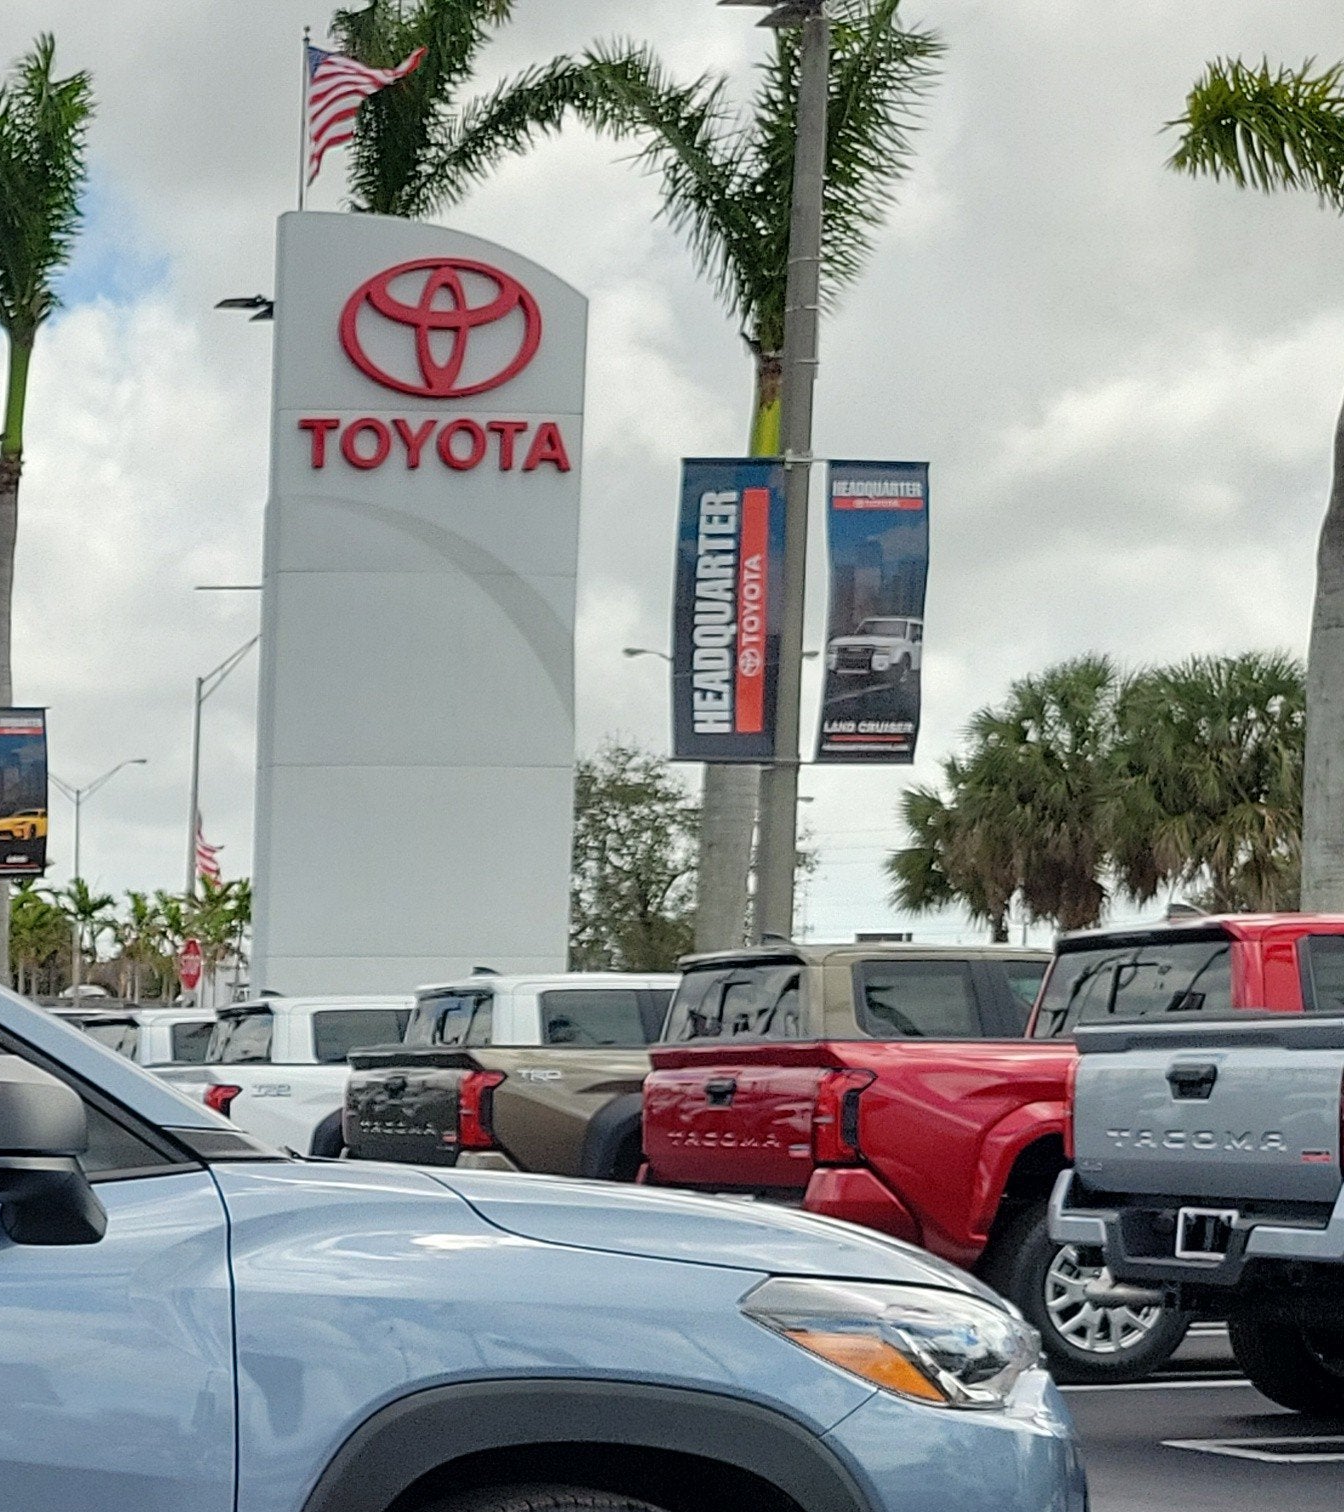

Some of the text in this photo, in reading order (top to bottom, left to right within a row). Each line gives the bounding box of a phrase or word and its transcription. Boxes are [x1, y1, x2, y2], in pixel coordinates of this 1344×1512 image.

[298, 417, 572, 473] TOYOTA
[693, 491, 739, 734] HEADQUARTER
[741, 553, 762, 646] TOYOTA
[823, 721, 856, 733] LAND
[667, 1131, 781, 1148] TACOMA
[1106, 1128, 1288, 1151] TACOMA
